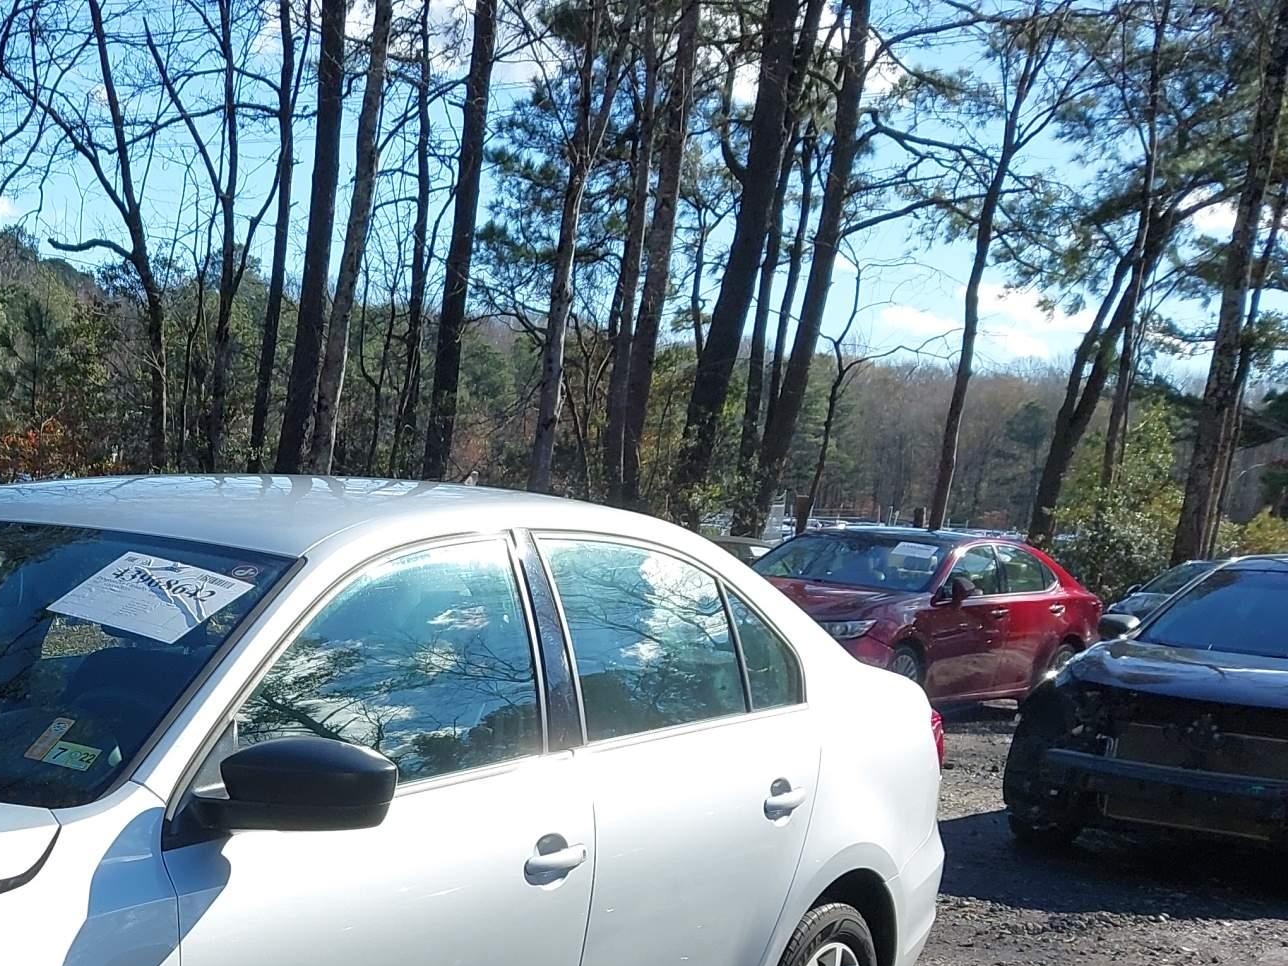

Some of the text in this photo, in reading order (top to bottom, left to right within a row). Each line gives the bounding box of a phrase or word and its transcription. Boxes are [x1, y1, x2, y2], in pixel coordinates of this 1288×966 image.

[112, 566, 217, 602] 43968642
[52, 747, 97, 763] 7 22
